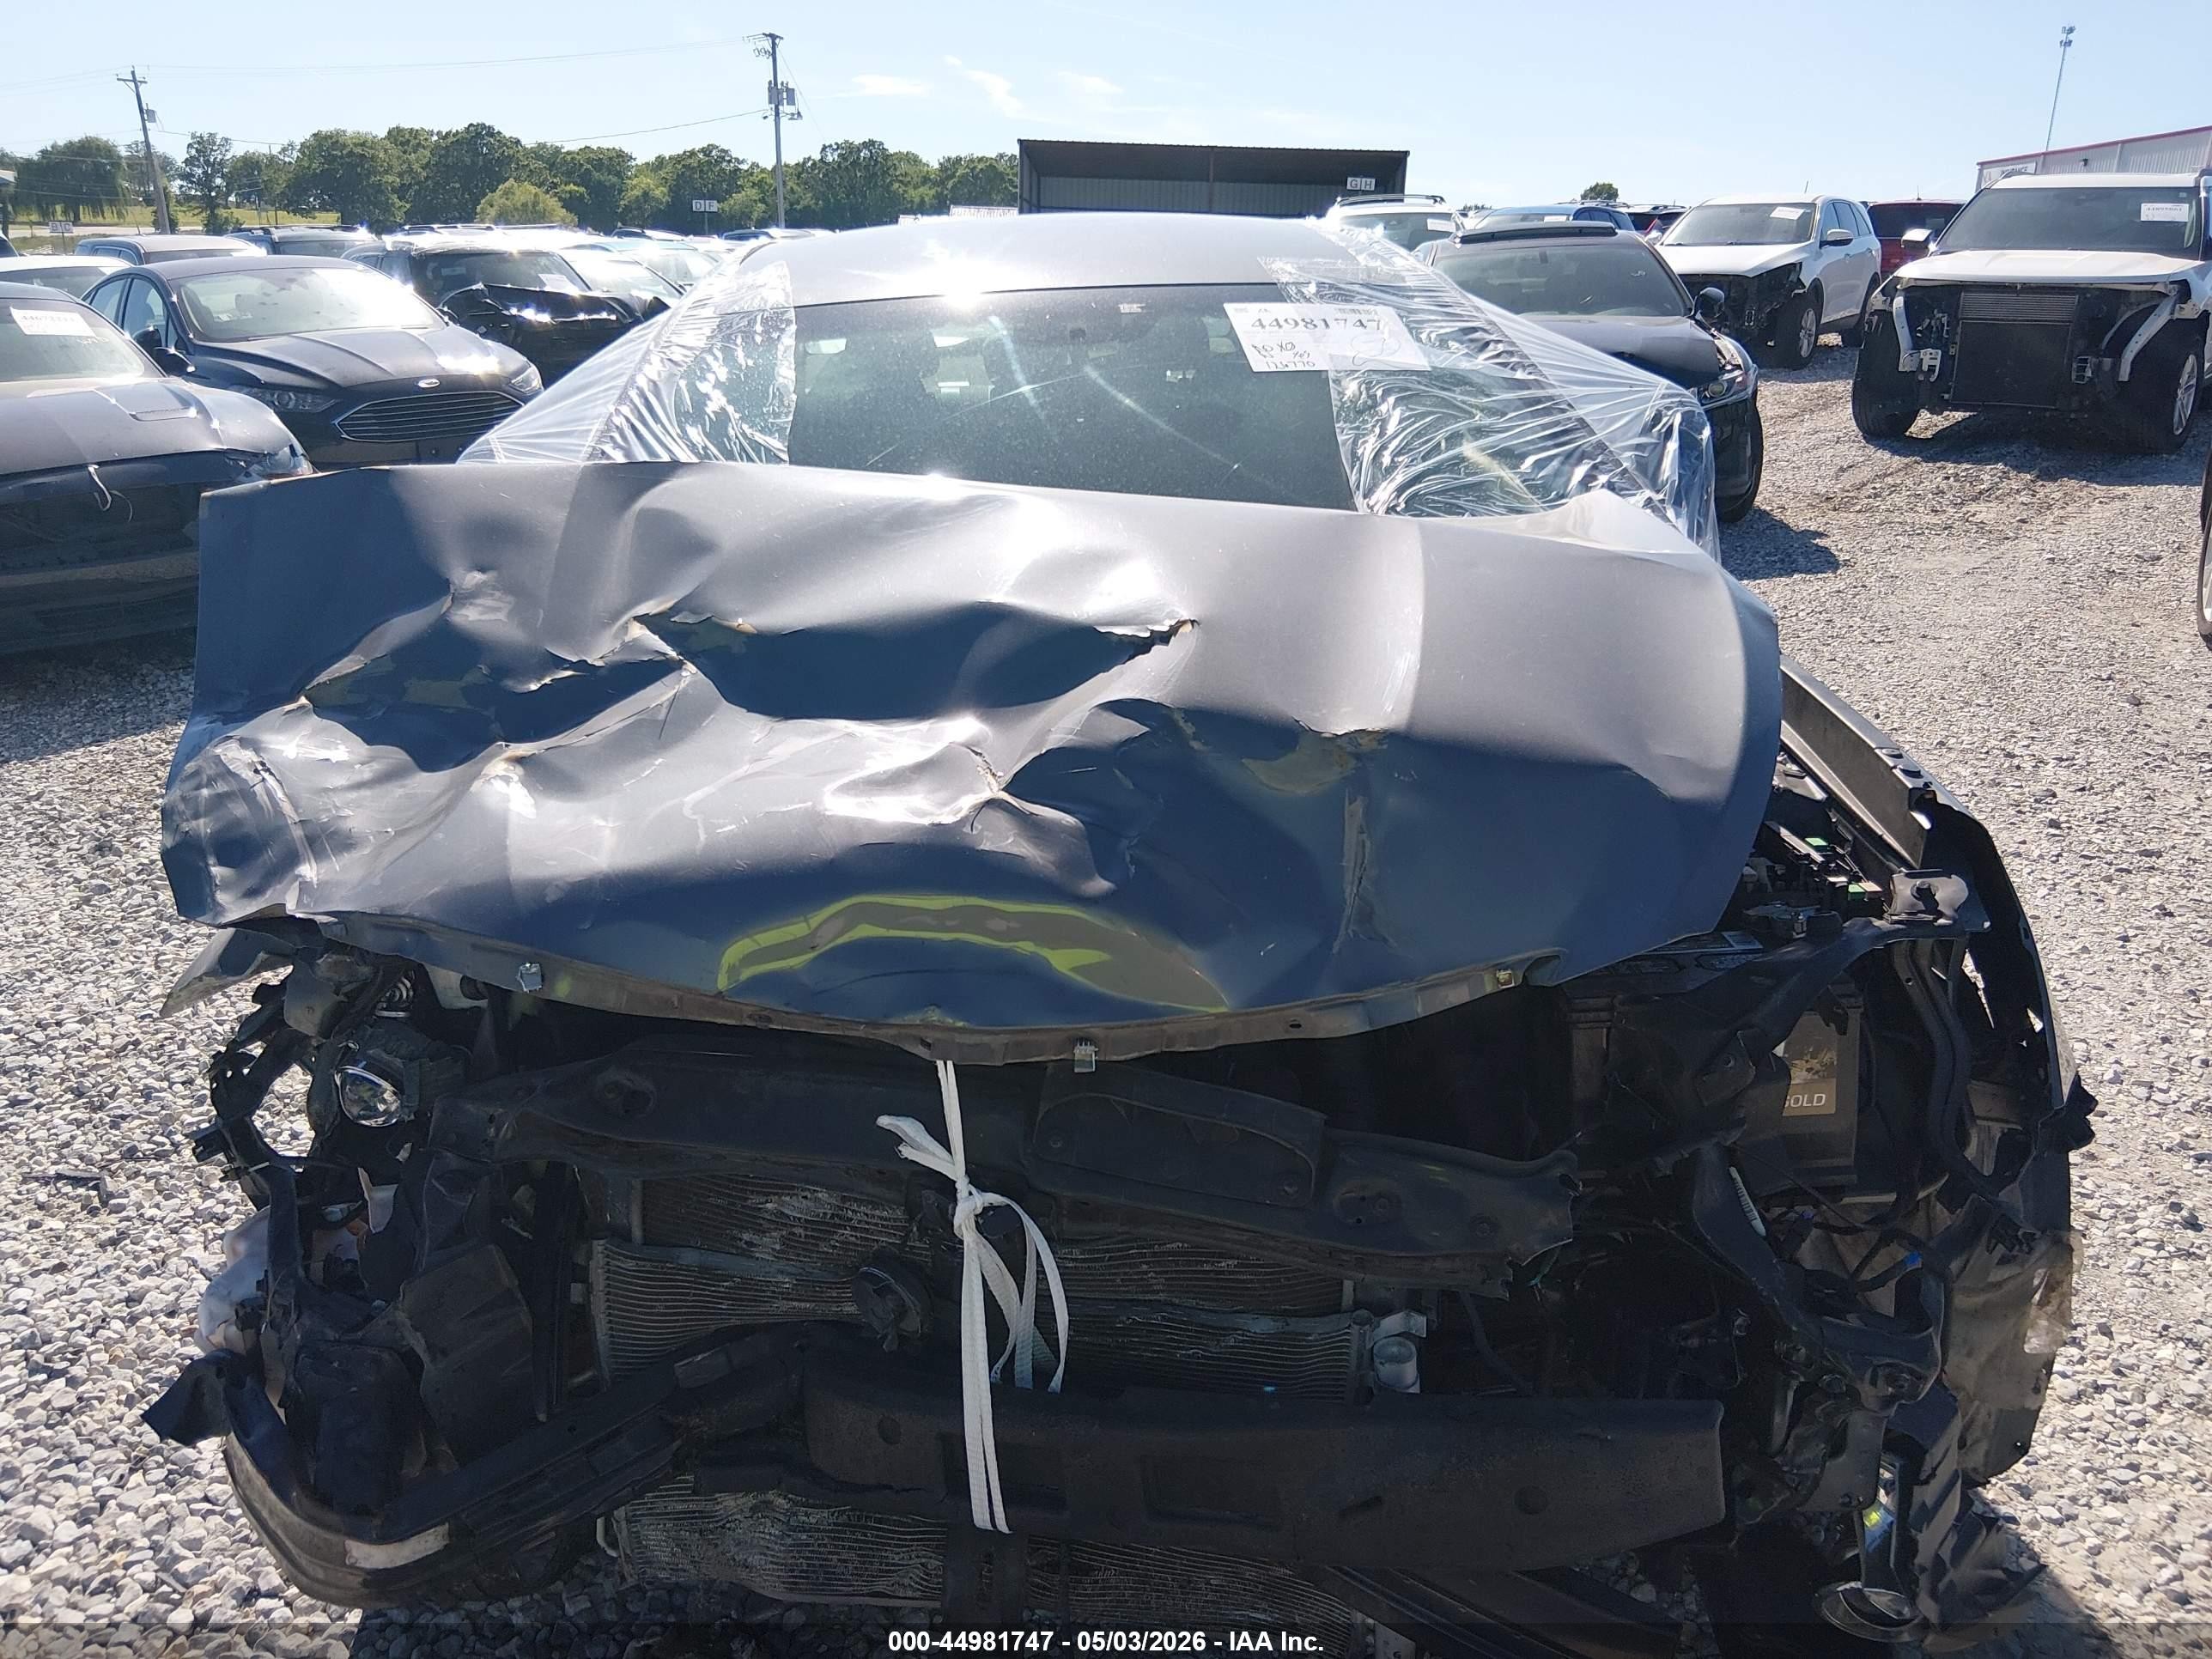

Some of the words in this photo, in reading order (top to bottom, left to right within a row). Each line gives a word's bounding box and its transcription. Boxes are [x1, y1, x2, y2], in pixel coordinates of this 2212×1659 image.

[1351, 179, 1358, 188] G
[1364, 179, 1372, 189] H
[696, 202, 702, 210] D
[708, 201, 715, 210] F
[1251, 317, 1381, 331] 44981747
